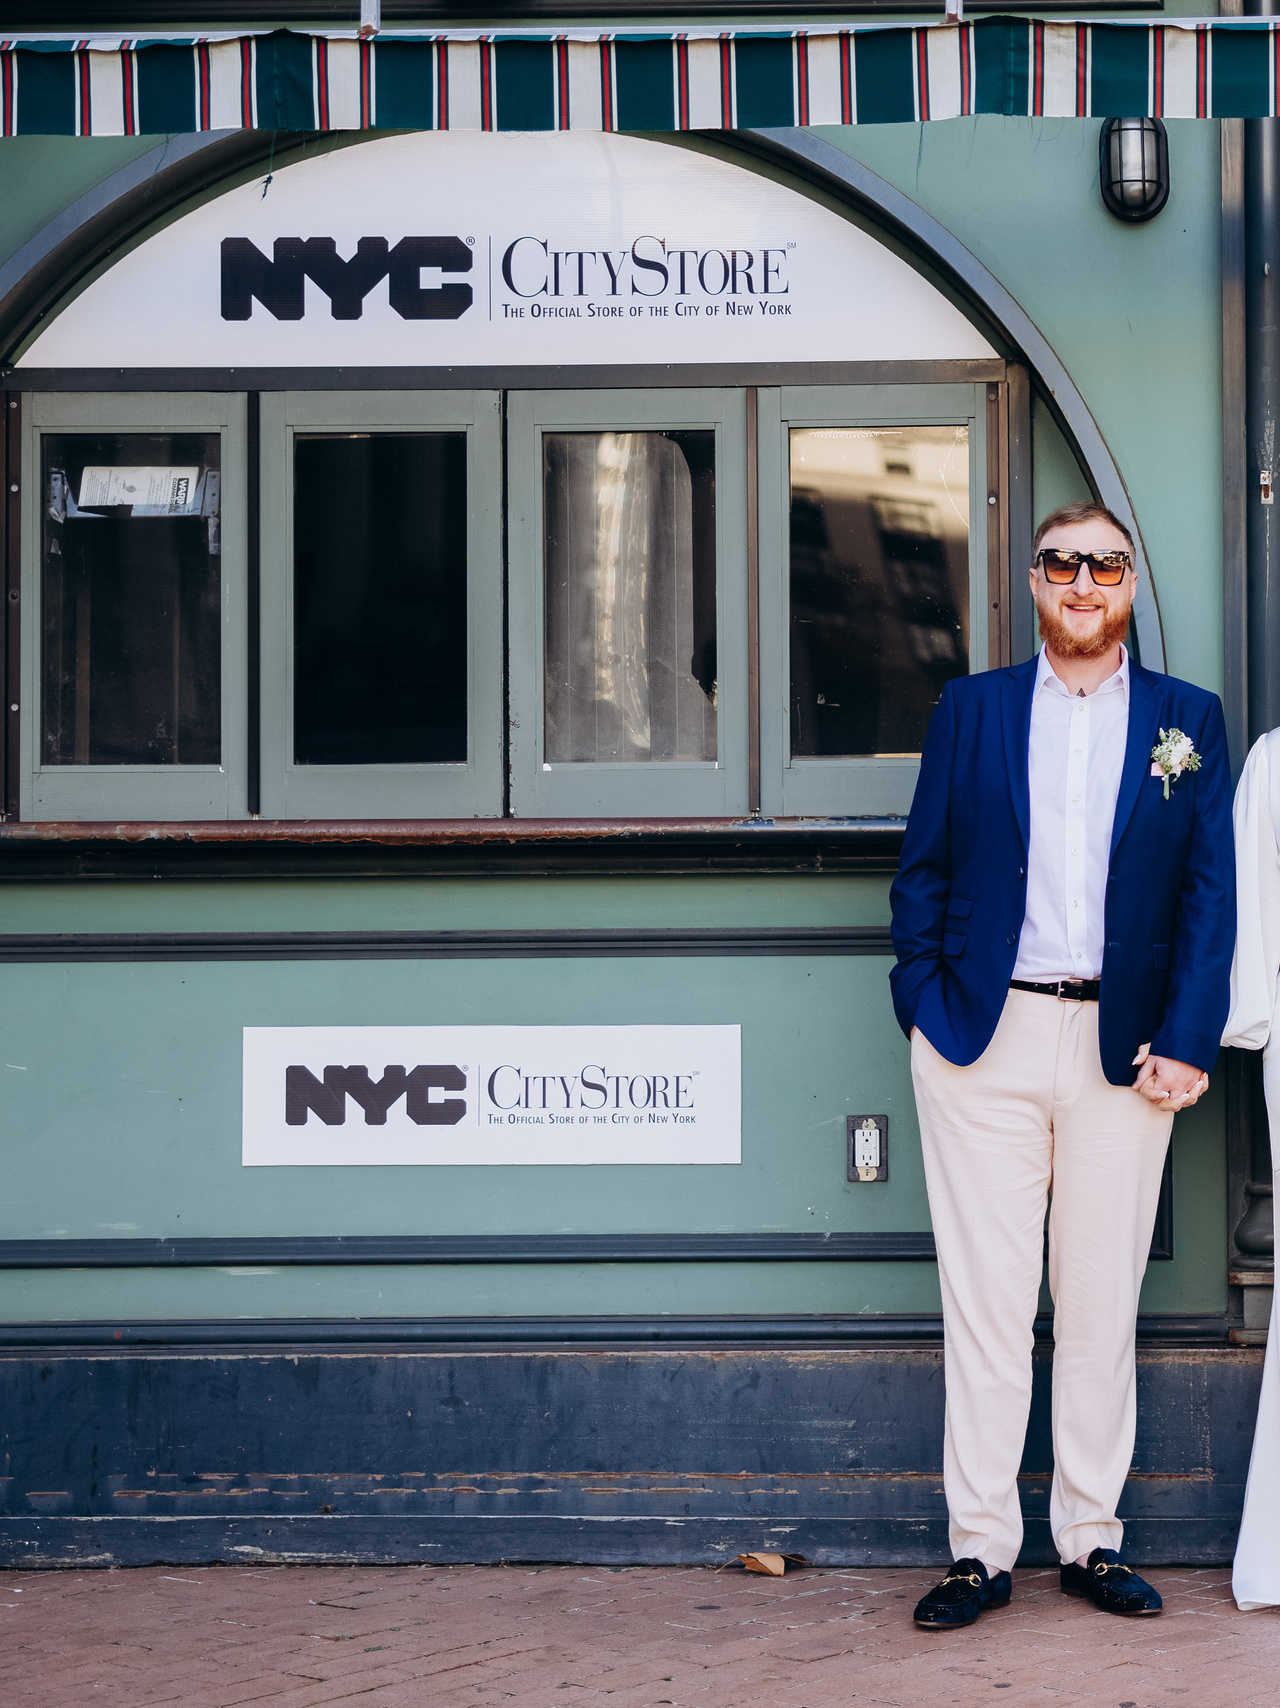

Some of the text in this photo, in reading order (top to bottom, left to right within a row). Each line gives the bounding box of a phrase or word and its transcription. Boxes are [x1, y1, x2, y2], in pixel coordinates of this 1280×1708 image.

[221, 237, 472, 320] NYC
[502, 236, 788, 297] CITYSTORE
[502, 301, 791, 318] THE OFFICIAL STORE OF THE CITY OF NEW YORK
[176, 479, 187, 506] WARIN
[285, 1065, 467, 1125] NYC
[488, 1065, 694, 1109] CITYSTORE
[487, 1113, 696, 1124] THE OFFICIAL STORE OF THE CITY OF NEW YORK
